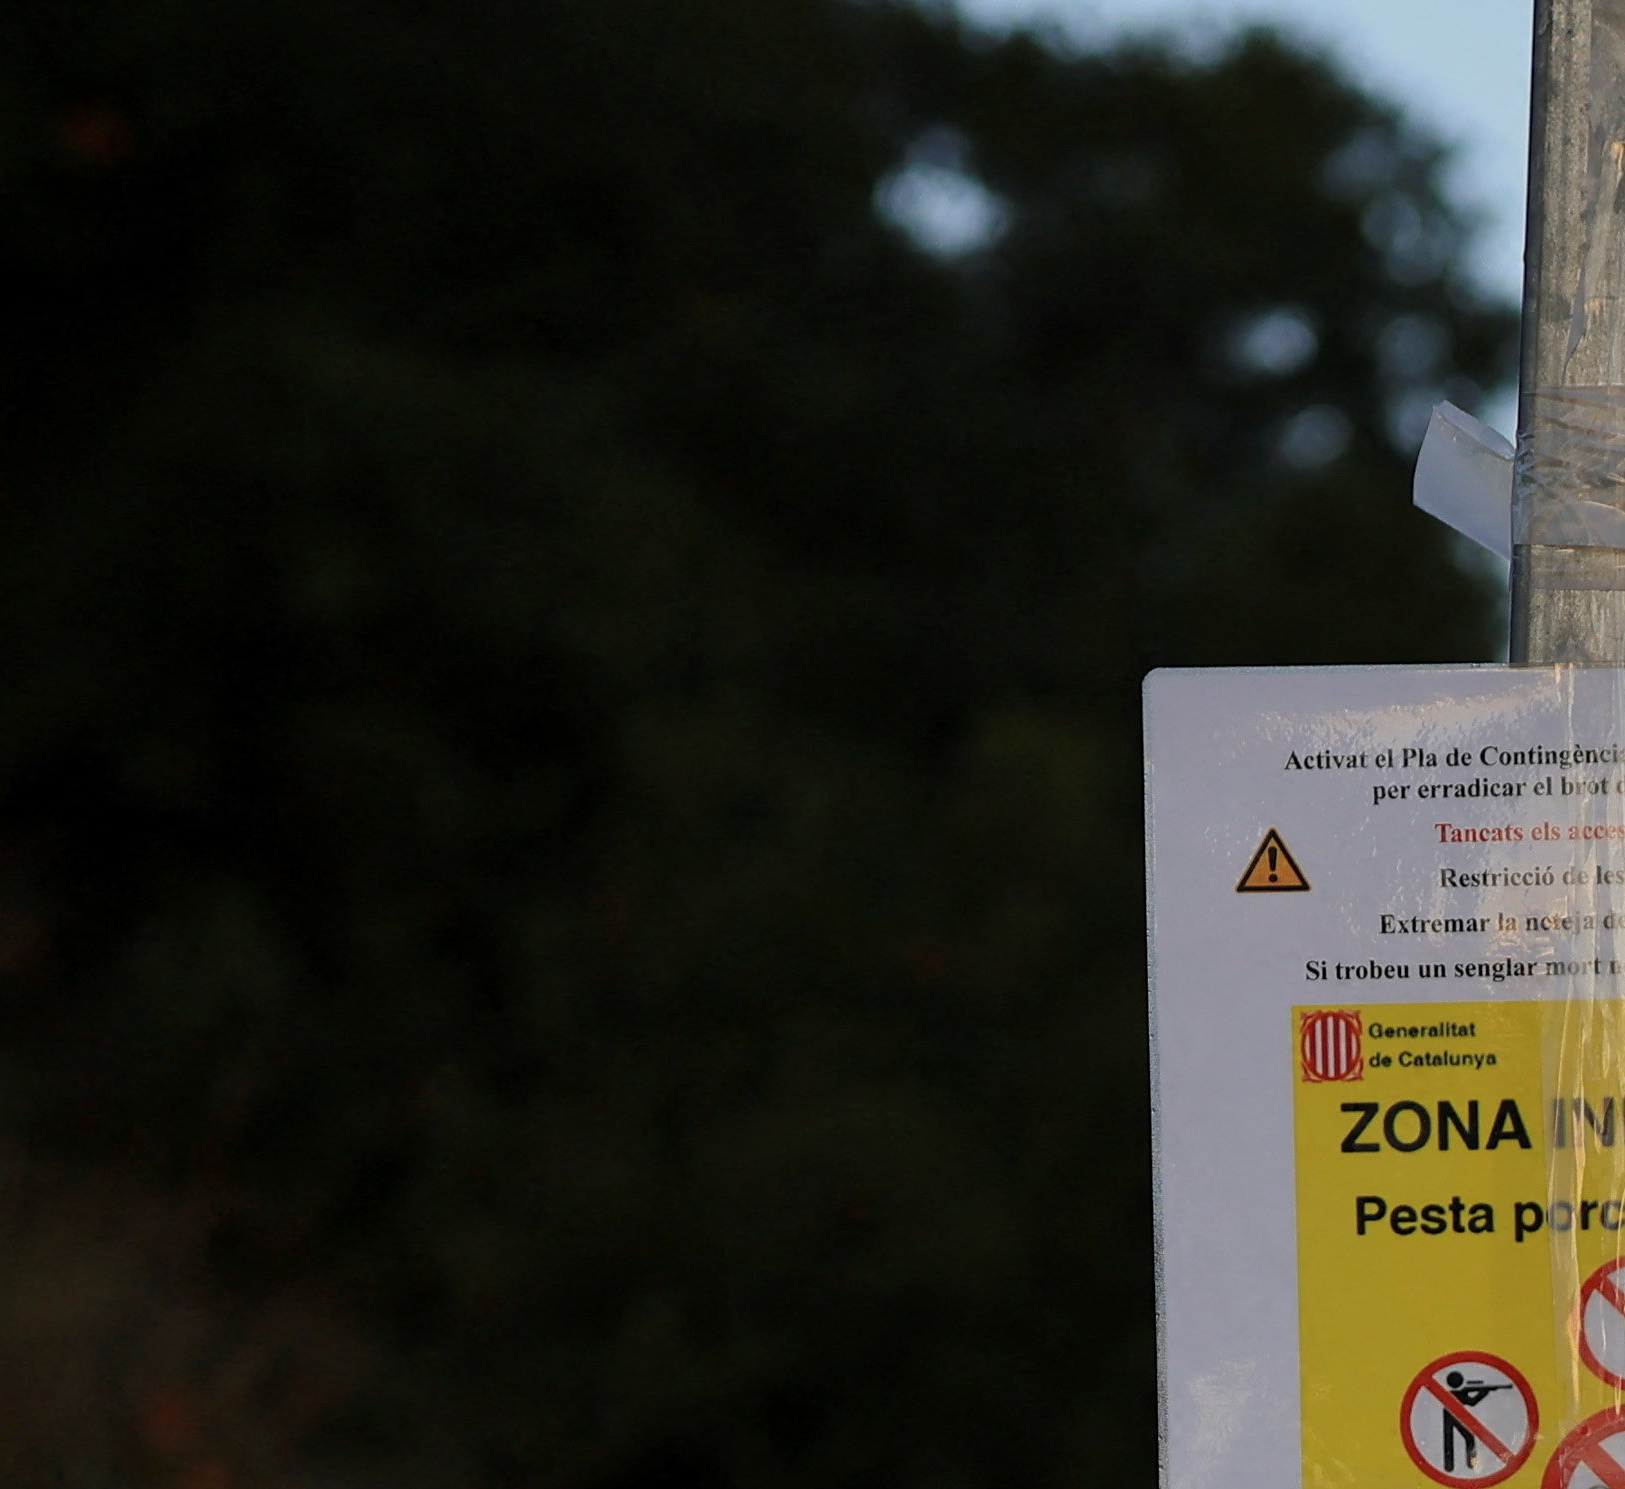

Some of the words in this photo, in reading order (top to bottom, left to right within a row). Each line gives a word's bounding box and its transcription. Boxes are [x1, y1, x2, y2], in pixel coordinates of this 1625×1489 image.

[1285, 749, 1368, 770] Activat
[1375, 747, 1393, 768] el
[1401, 747, 1437, 768] Pla
[1446, 745, 1472, 766] de
[1373, 781, 1410, 805] per
[1417, 778, 1527, 799] erradicar
[1533, 777, 1552, 796] el
[1561, 777, 1608, 796] brot
[1435, 821, 1524, 843] Tancats
[1531, 820, 1560, 841] els
[1440, 864, 1553, 888] Restricció
[1562, 864, 1589, 885] de
[1596, 863, 1624, 884] les
[1380, 911, 1489, 934] Extremar
[1498, 911, 1517, 931] la
[1306, 959, 1327, 981] Si
[1335, 957, 1410, 980] trobeu
[1418, 962, 1446, 978] un
[1454, 953, 1538, 982] senglar
[1545, 955, 1601, 975] mort
[1368, 1022, 1476, 1039] Generalitat
[1369, 1053, 1392, 1067] de
[1399, 1050, 1497, 1070] Catalunya
[1340, 1097, 1532, 1154] ZONA
[1355, 1194, 1496, 1236] Pesta
